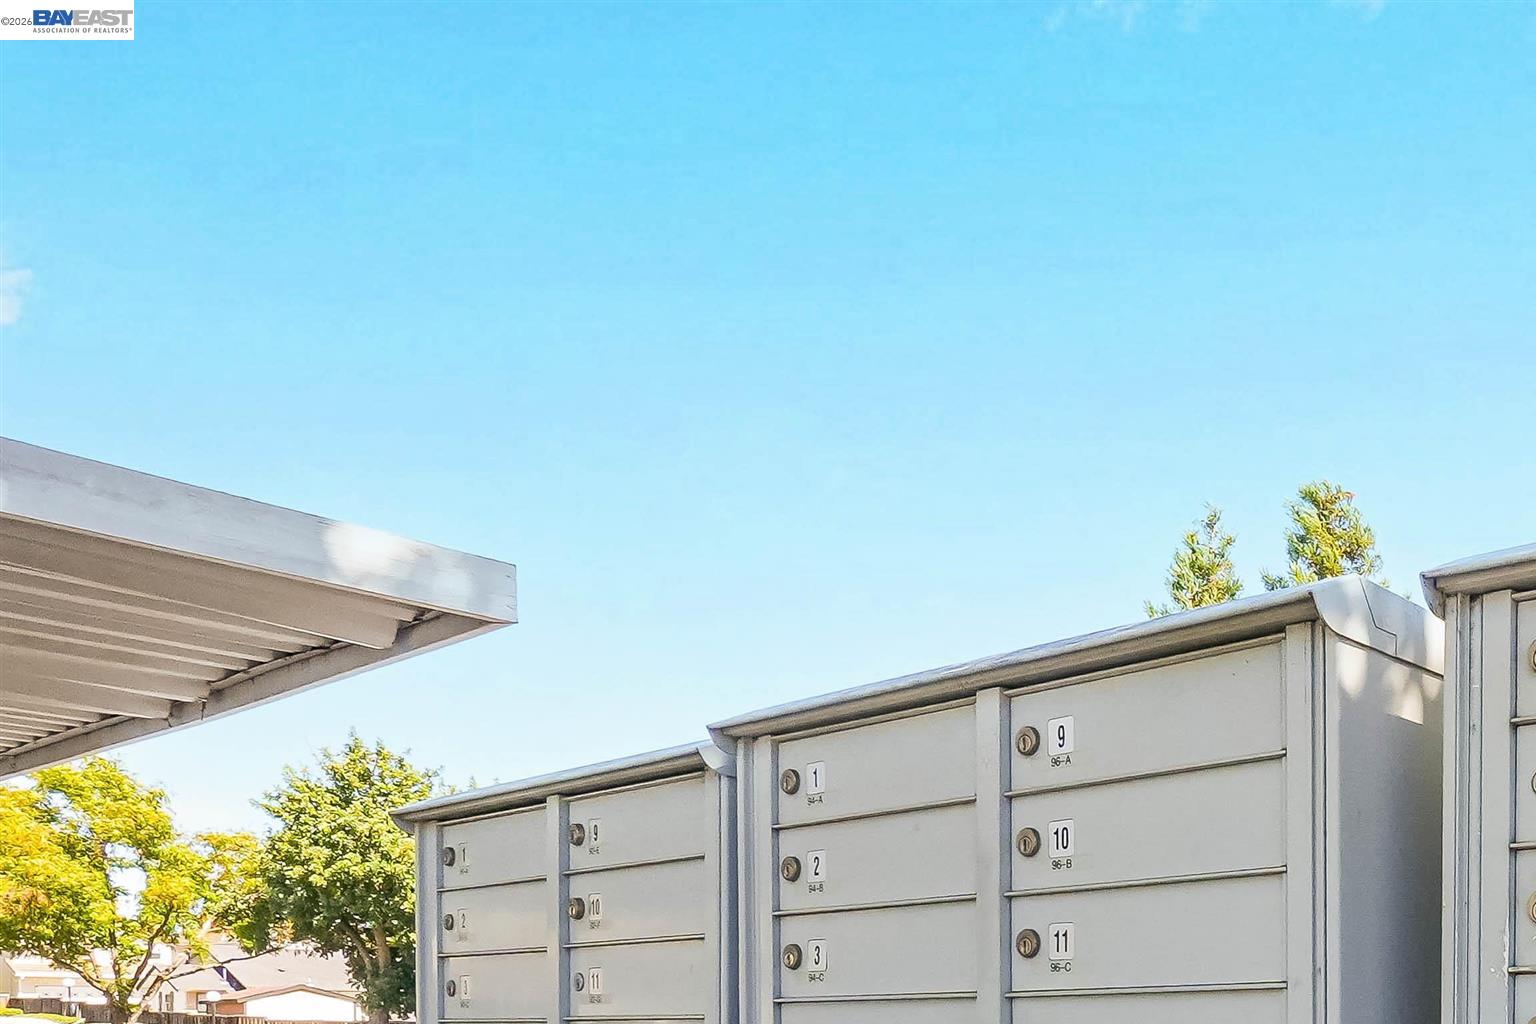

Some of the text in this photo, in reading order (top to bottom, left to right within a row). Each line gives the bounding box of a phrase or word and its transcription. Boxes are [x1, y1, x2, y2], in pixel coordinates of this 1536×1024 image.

[1057, 724, 1065, 748] 9
[1050, 755, 1072, 767] 96-A
[812, 768, 818, 788] 1
[593, 824, 598, 842] 9
[1053, 826, 1069, 851] 10
[813, 856, 820, 876] 2
[1051, 860, 1073, 871] 96-B
[591, 898, 600, 916] 10
[1054, 929, 1069, 953] 11
[814, 945, 821, 965] 3
[1050, 961, 1072, 973] 96-C
[591, 976, 600, 990] 11
